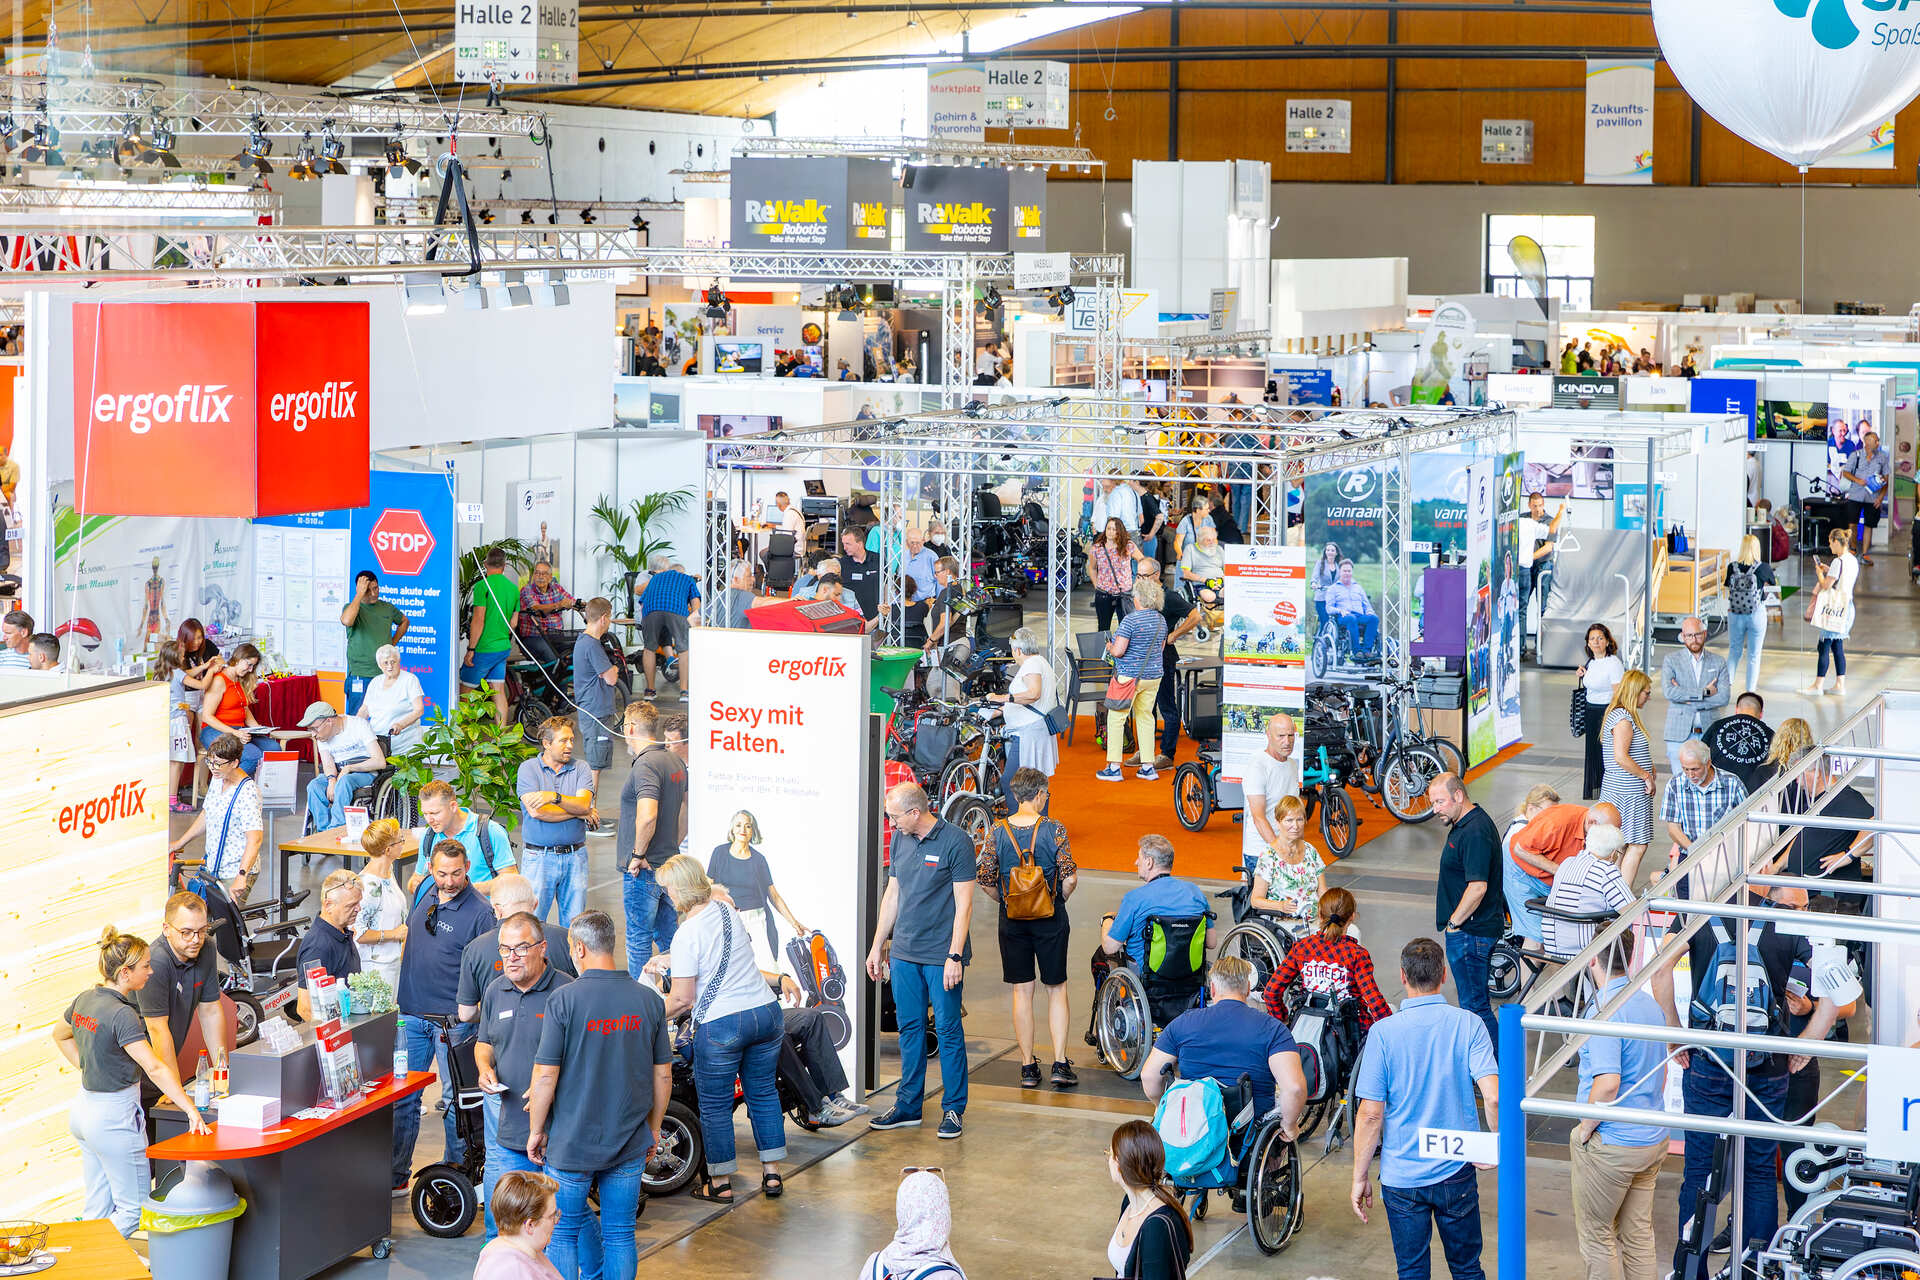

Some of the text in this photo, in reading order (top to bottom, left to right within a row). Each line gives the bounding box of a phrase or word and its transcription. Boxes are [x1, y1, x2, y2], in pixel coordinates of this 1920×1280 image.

[461, 4, 532, 25] Halle 2
[539, 5, 577, 28] Halle 2
[988, 70, 1043, 85] Halle 2
[930, 84, 982, 95] Marktplatz
[1289, 107, 1334, 120] Halle 2
[1590, 103, 1649, 116] Zukunfts-
[934, 111, 977, 123] Gehirn &
[1596, 115, 1643, 129] pavillon
[930, 123, 982, 134] Neuroreha
[1484, 126, 1523, 137] Halle 2
[745, 199, 828, 223] ReWalk
[852, 202, 887, 226] ReWalk
[917, 203, 993, 224] ReWalk
[1013, 205, 1041, 227] ReWalk
[782, 223, 828, 236] Robotics
[951, 223, 993, 236] Robotics
[769, 235, 784, 244] Take
[784, 235, 796, 244] the
[811, 236, 826, 245] Step
[940, 234, 953, 243] Take
[953, 235, 964, 243] the
[977, 235, 991, 245] Step
[580, 269, 616, 280] GMBH
[756, 325, 785, 335] Service
[1558, 384, 1615, 394] KINOVA
[94, 384, 235, 434] ergoflix
[270, 381, 358, 432] ergoflix
[467, 504, 482, 512] E17
[1327, 506, 1384, 519] vanraam
[468, 513, 482, 522] E21
[376, 531, 428, 552] STOP
[1414, 543, 1430, 551] F19
[399, 586, 423, 596] akute
[423, 588, 441, 597] oder
[768, 656, 847, 681] ergoflix
[710, 701, 804, 729] Sexy mit
[174, 737, 188, 750] F13
[710, 730, 785, 754] Falten.
[58, 779, 147, 839] ergoflix
[264, 991, 291, 1010] ergoflix
[587, 1014, 642, 1036] ergoflix
[1426, 1134, 1464, 1155] F12
